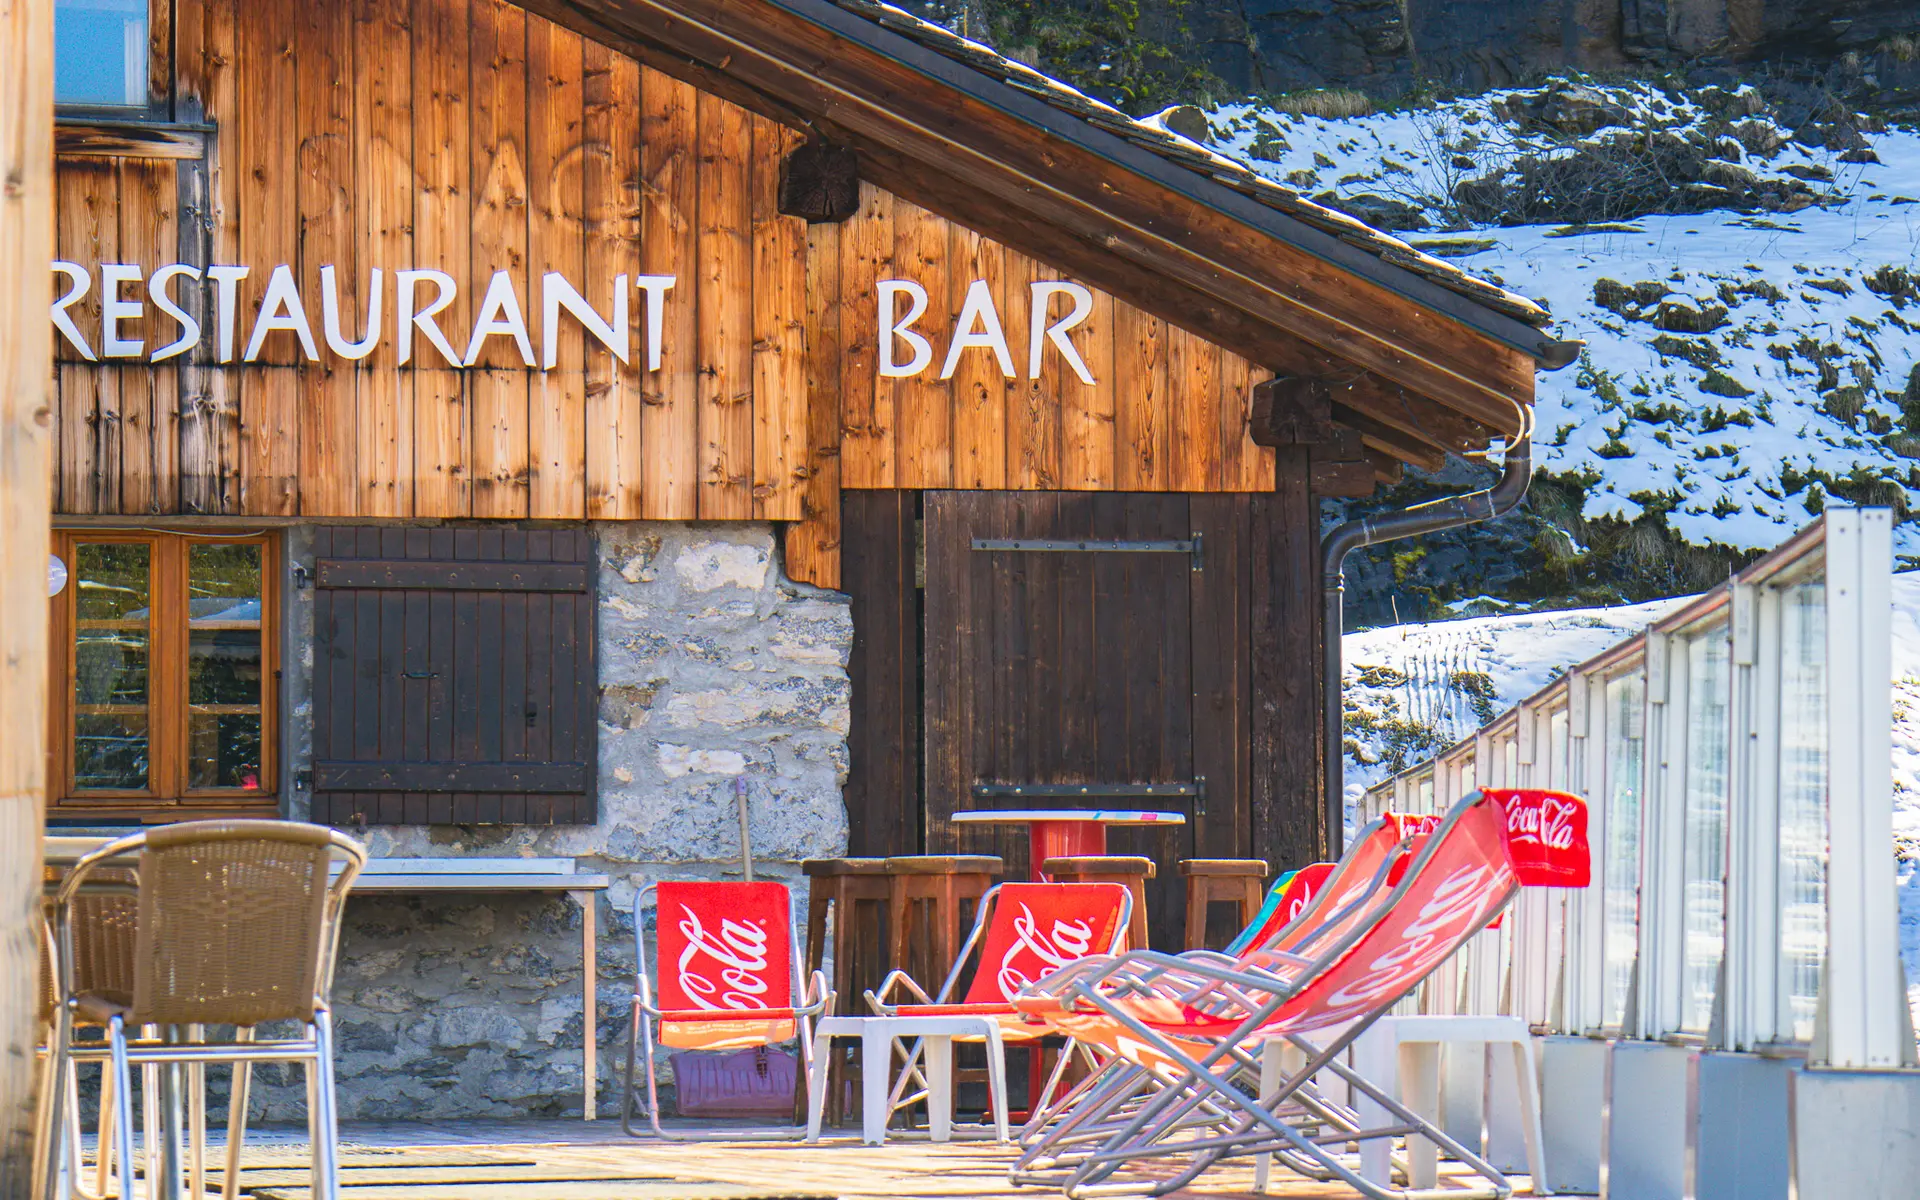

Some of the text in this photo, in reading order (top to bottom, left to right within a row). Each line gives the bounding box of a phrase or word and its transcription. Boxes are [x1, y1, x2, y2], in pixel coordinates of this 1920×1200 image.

[51, 261, 1096, 386] RESTAURANT BAR
[679, 903, 767, 1010] Cola
[998, 901, 1092, 1002] Cla
